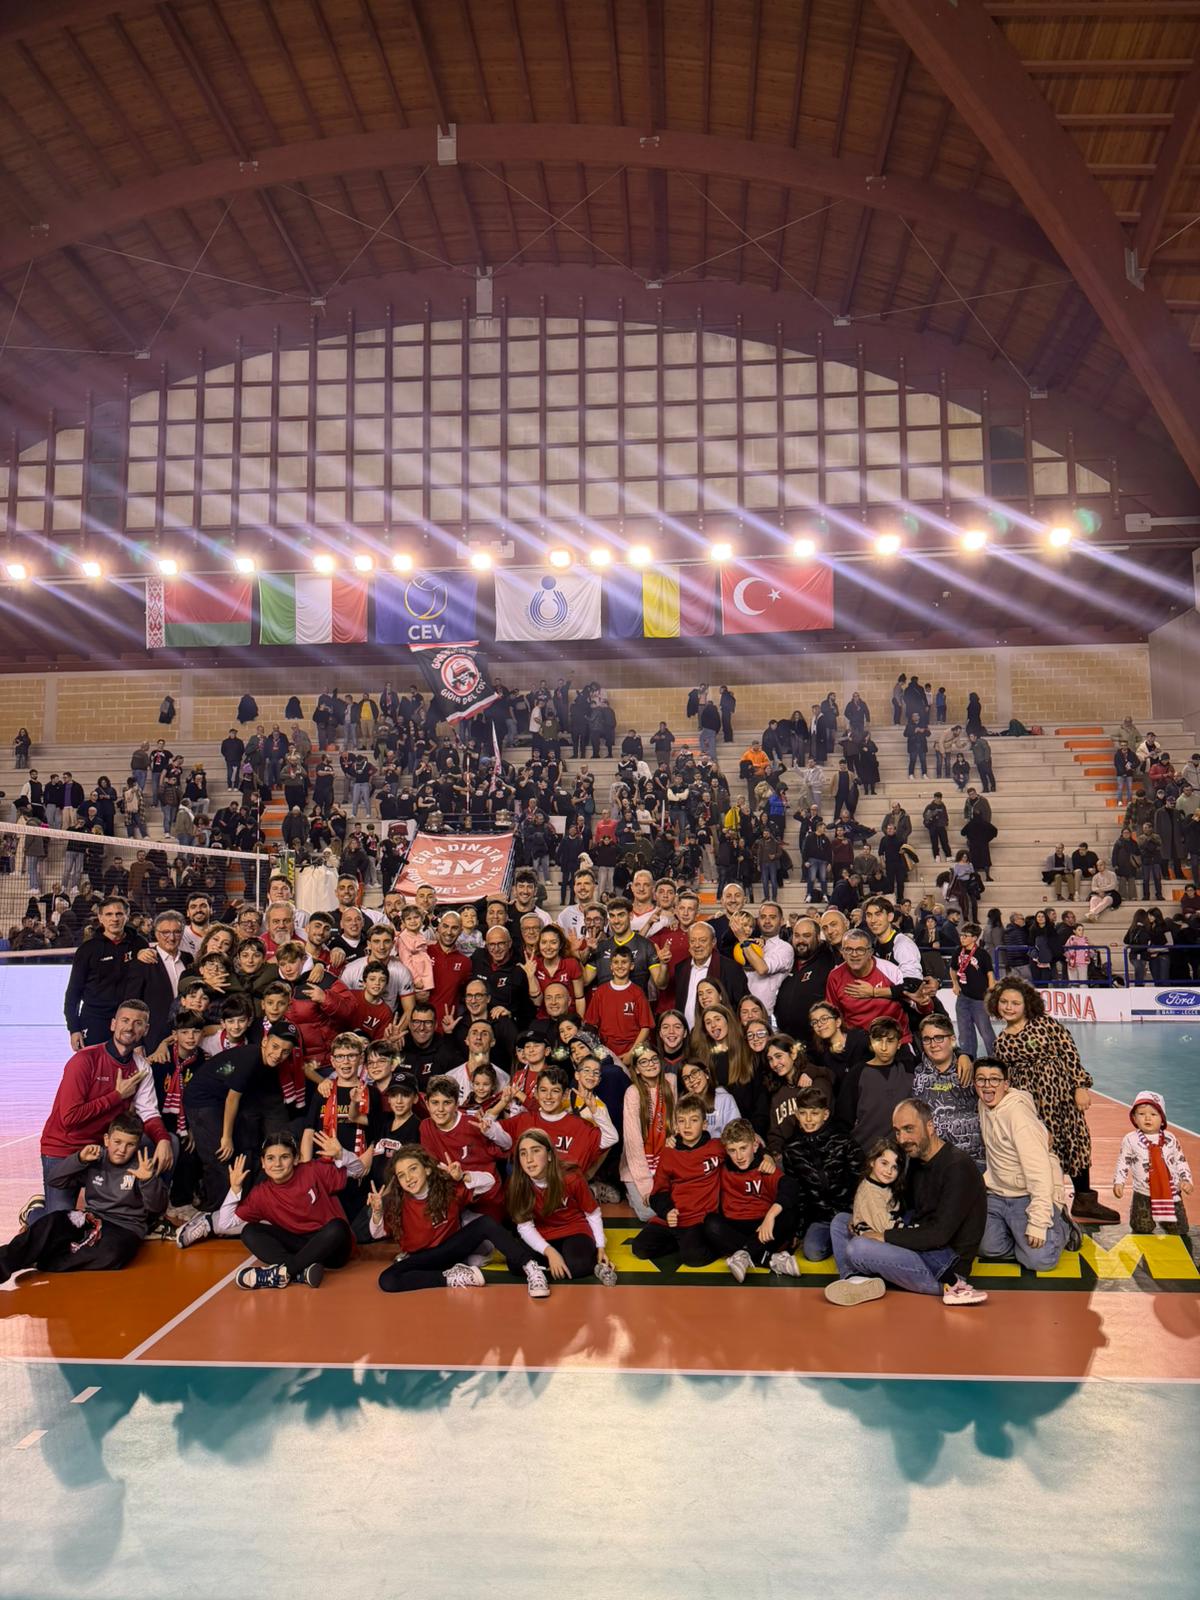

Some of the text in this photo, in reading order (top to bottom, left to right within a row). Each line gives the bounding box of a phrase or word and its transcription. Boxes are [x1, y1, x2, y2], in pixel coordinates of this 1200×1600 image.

[408, 624, 445, 640] CEV
[412, 843, 504, 864] GRADINATA
[466, 866, 502, 890] COLLE
[1040, 990, 1097, 1020] ORNA
[1165, 992, 1196, 1005] Ford
[555, 1136, 573, 1150] JV
[703, 1156, 719, 1172] JV
[745, 1179, 762, 1195] JV
